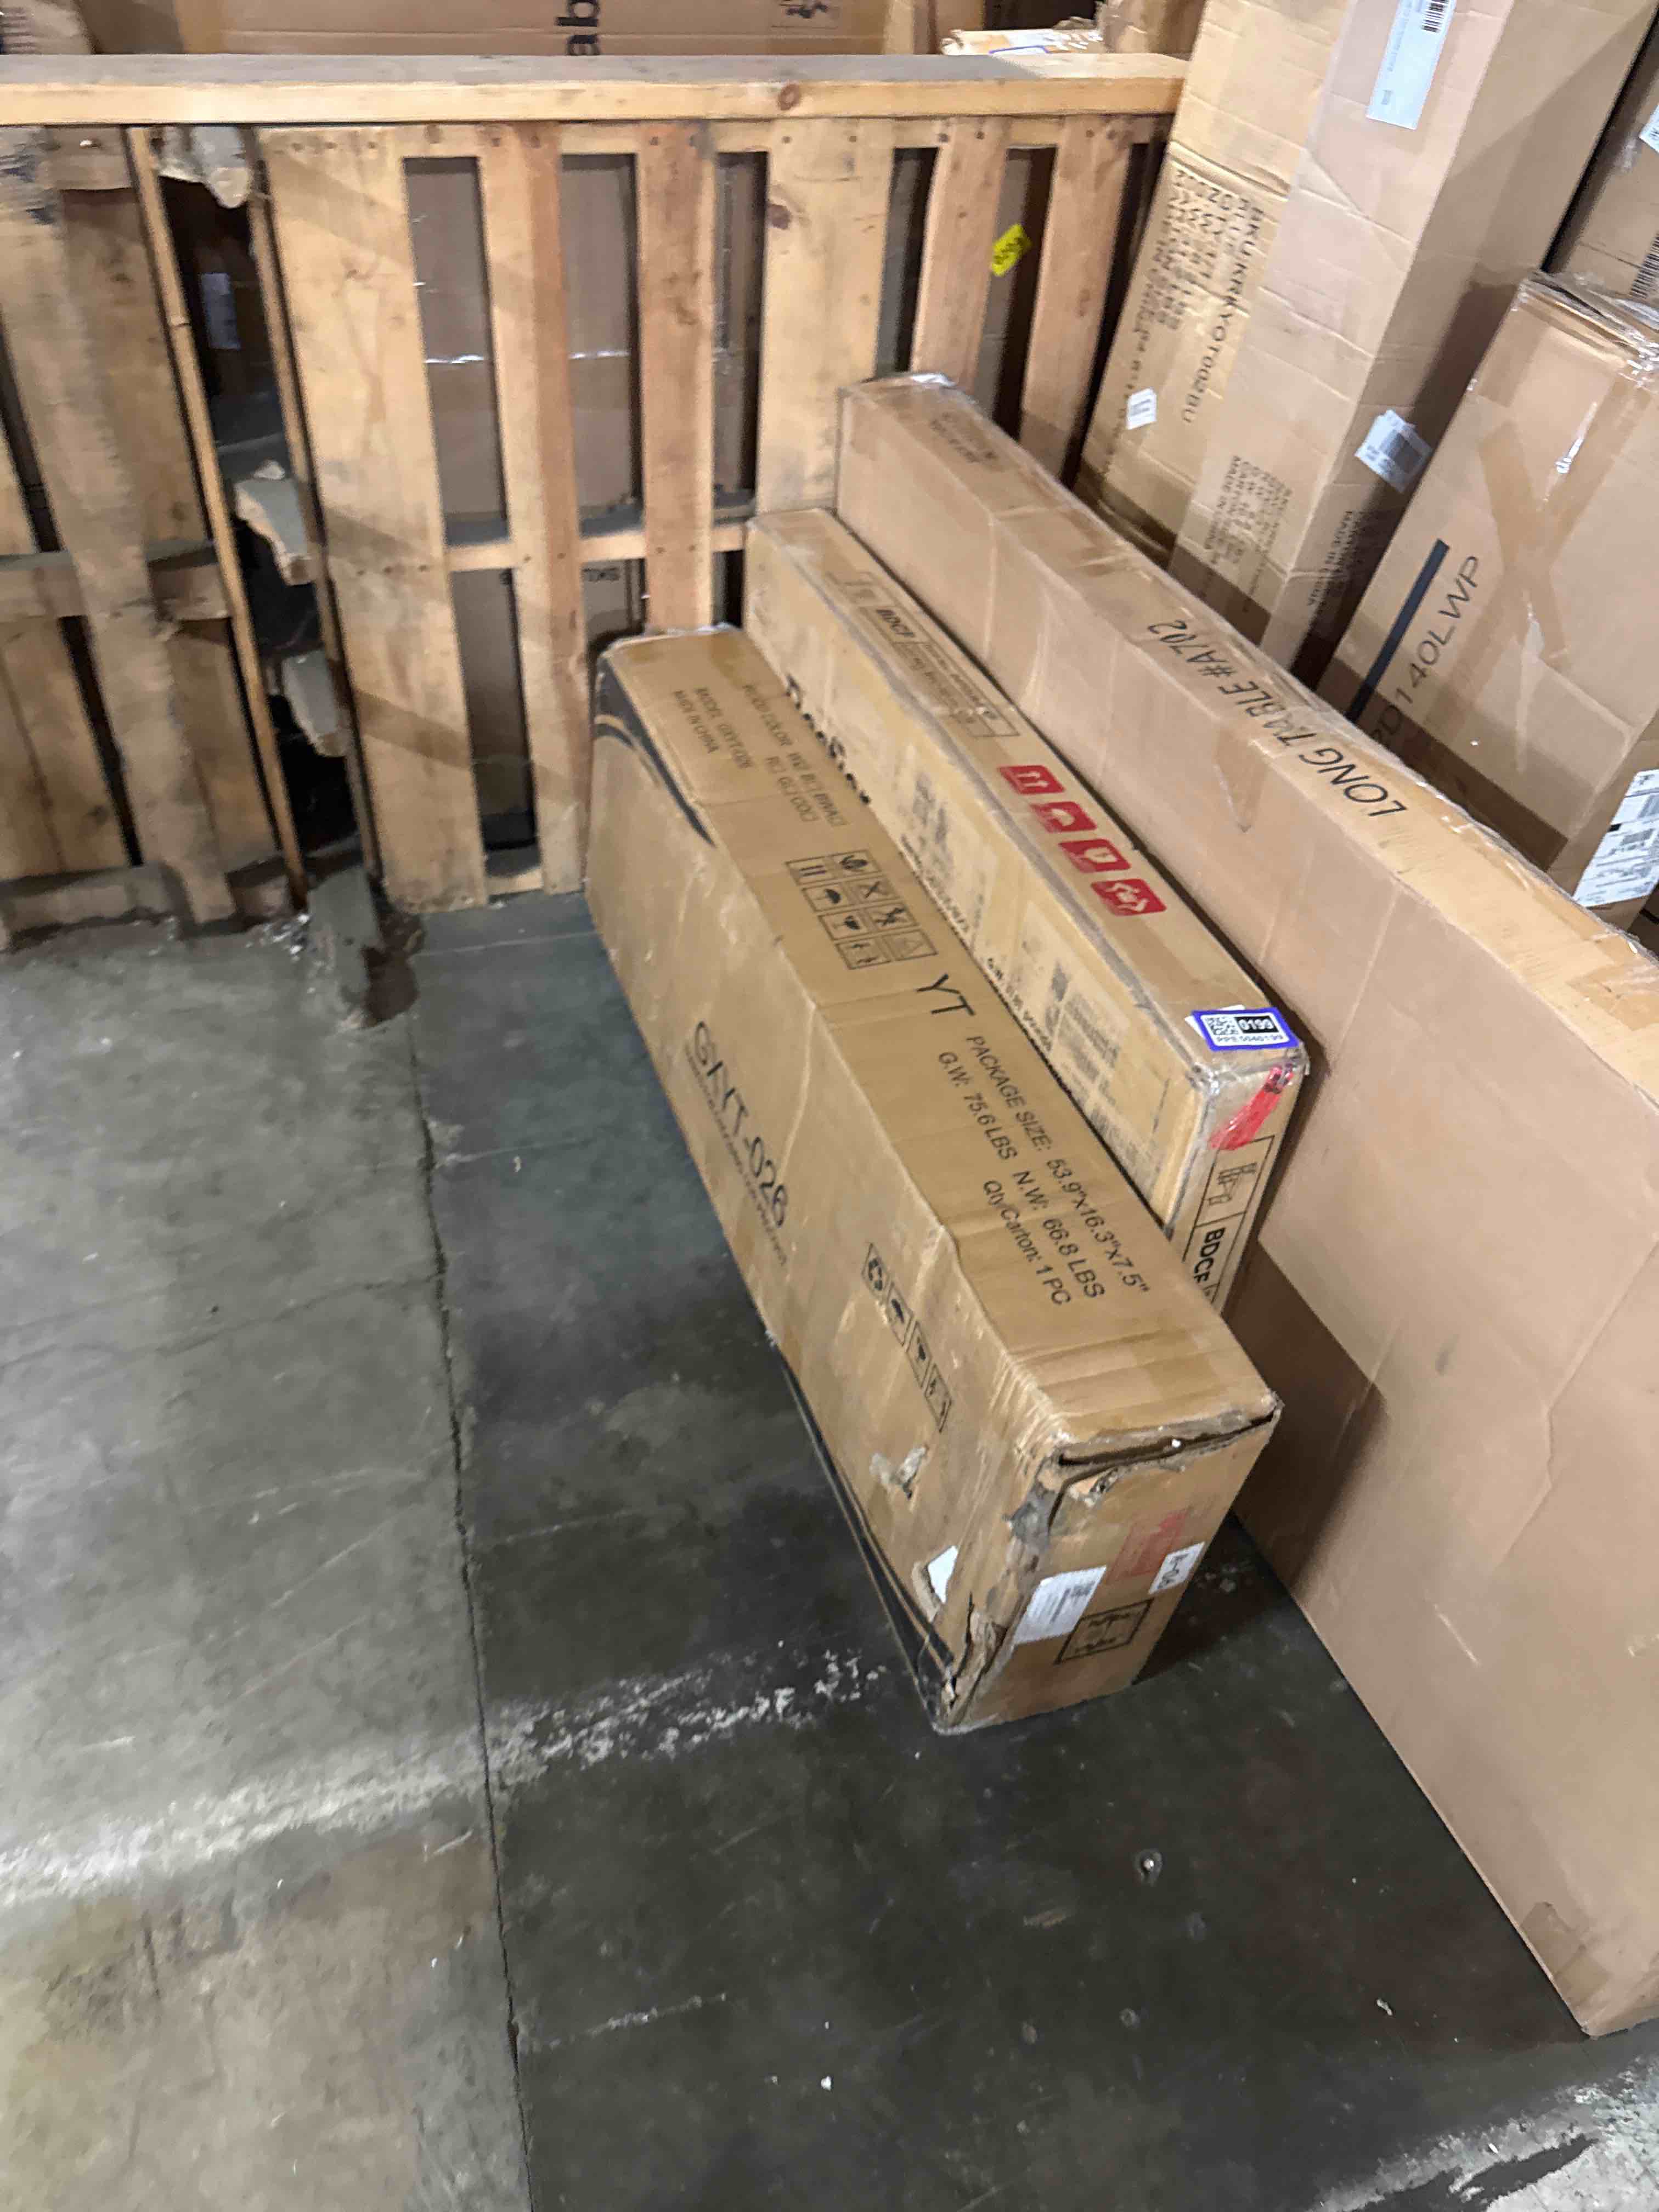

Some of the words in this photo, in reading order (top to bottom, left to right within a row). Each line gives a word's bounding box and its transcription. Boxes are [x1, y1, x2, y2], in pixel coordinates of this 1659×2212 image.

[1218, 681, 1316, 746] TABLE
[1299, 748, 1407, 817] LONG
[916, 973, 975, 1016] YT
[967, 1035, 1025, 1109] PACKAGE
[1015, 1110, 1053, 1151] SIZE:
[963, 1092, 996, 1126] 75.6
[984, 1126, 1018, 1160] LBS
[1043, 1218, 1079, 1256] 66.8
[1068, 1259, 1105, 1298] LBS
[1036, 1264, 1054, 1275] 1
[1043, 1277, 1071, 1305] PC
